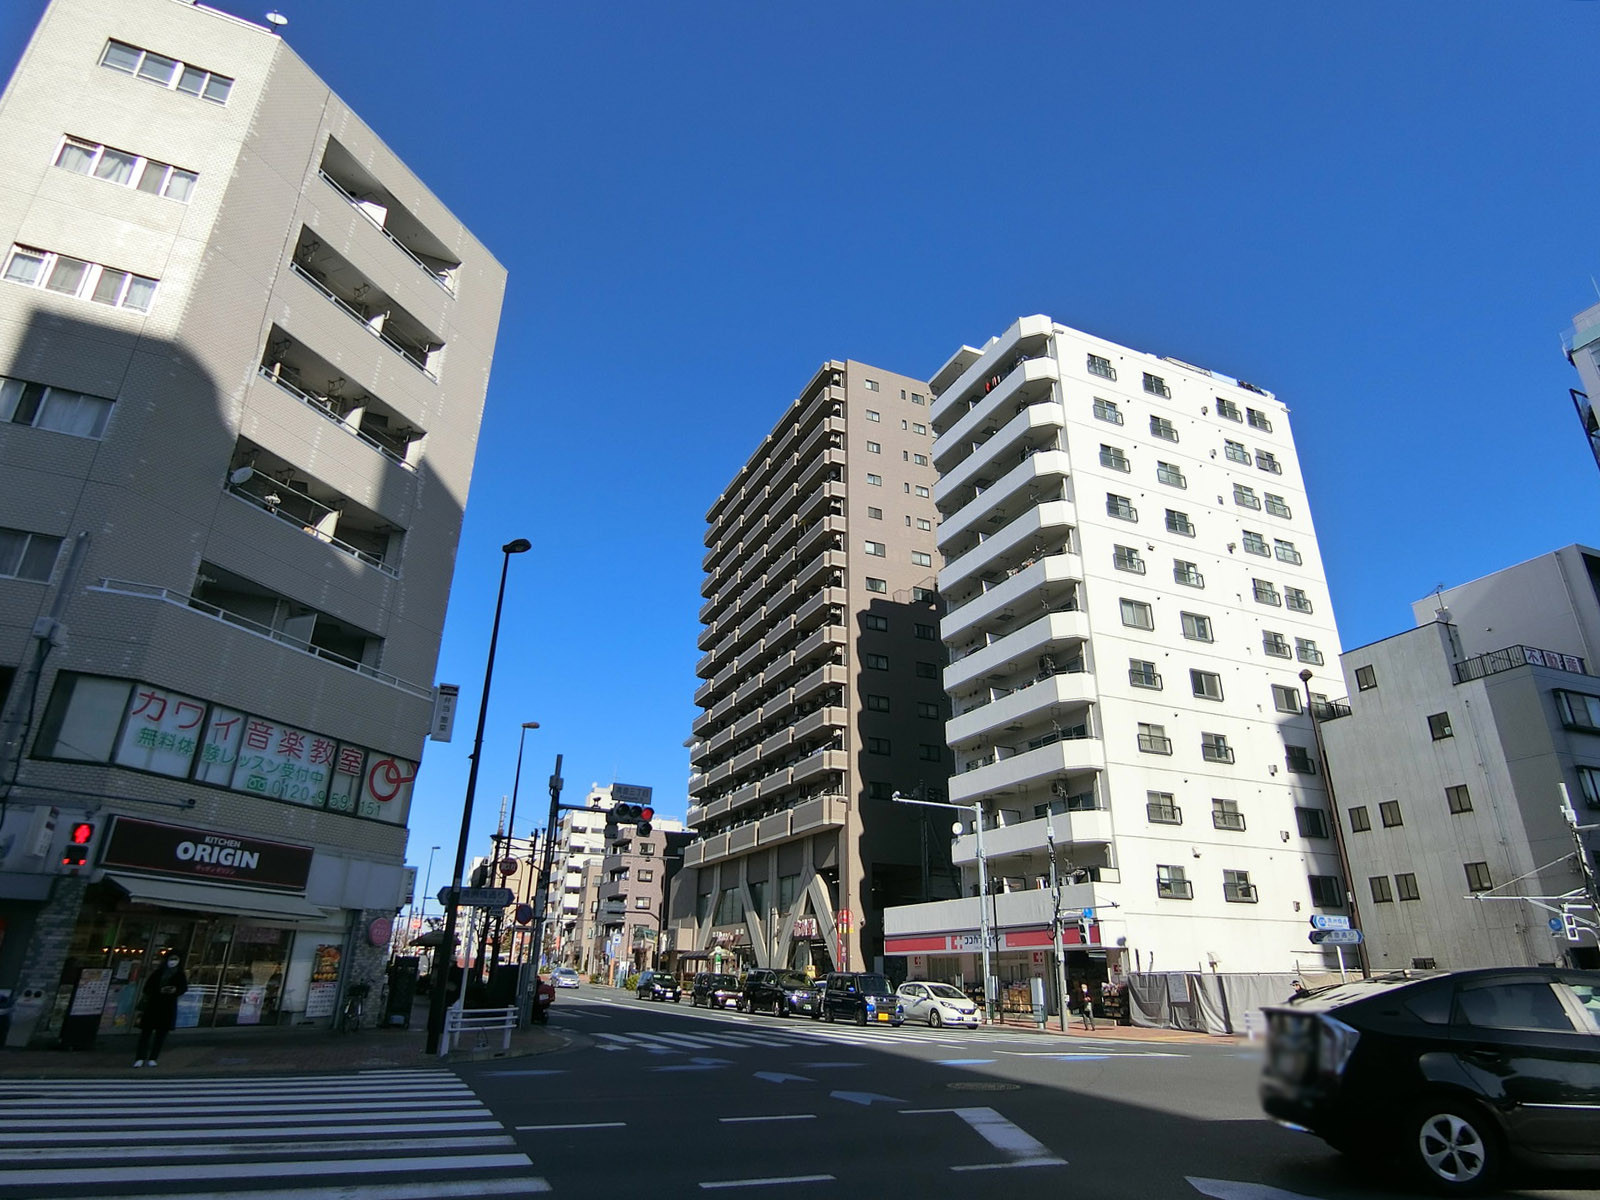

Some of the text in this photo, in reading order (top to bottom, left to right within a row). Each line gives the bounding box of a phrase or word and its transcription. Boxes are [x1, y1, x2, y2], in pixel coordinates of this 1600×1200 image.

[132, 691, 363, 776] カワイ音楽教室
[137, 727, 324, 784] 無料体験レッスン受付中
[616, 786, 650, 798] 三丁目
[176, 841, 260, 869] ORIGIN
[204, 835, 241, 848] KITCHEN
